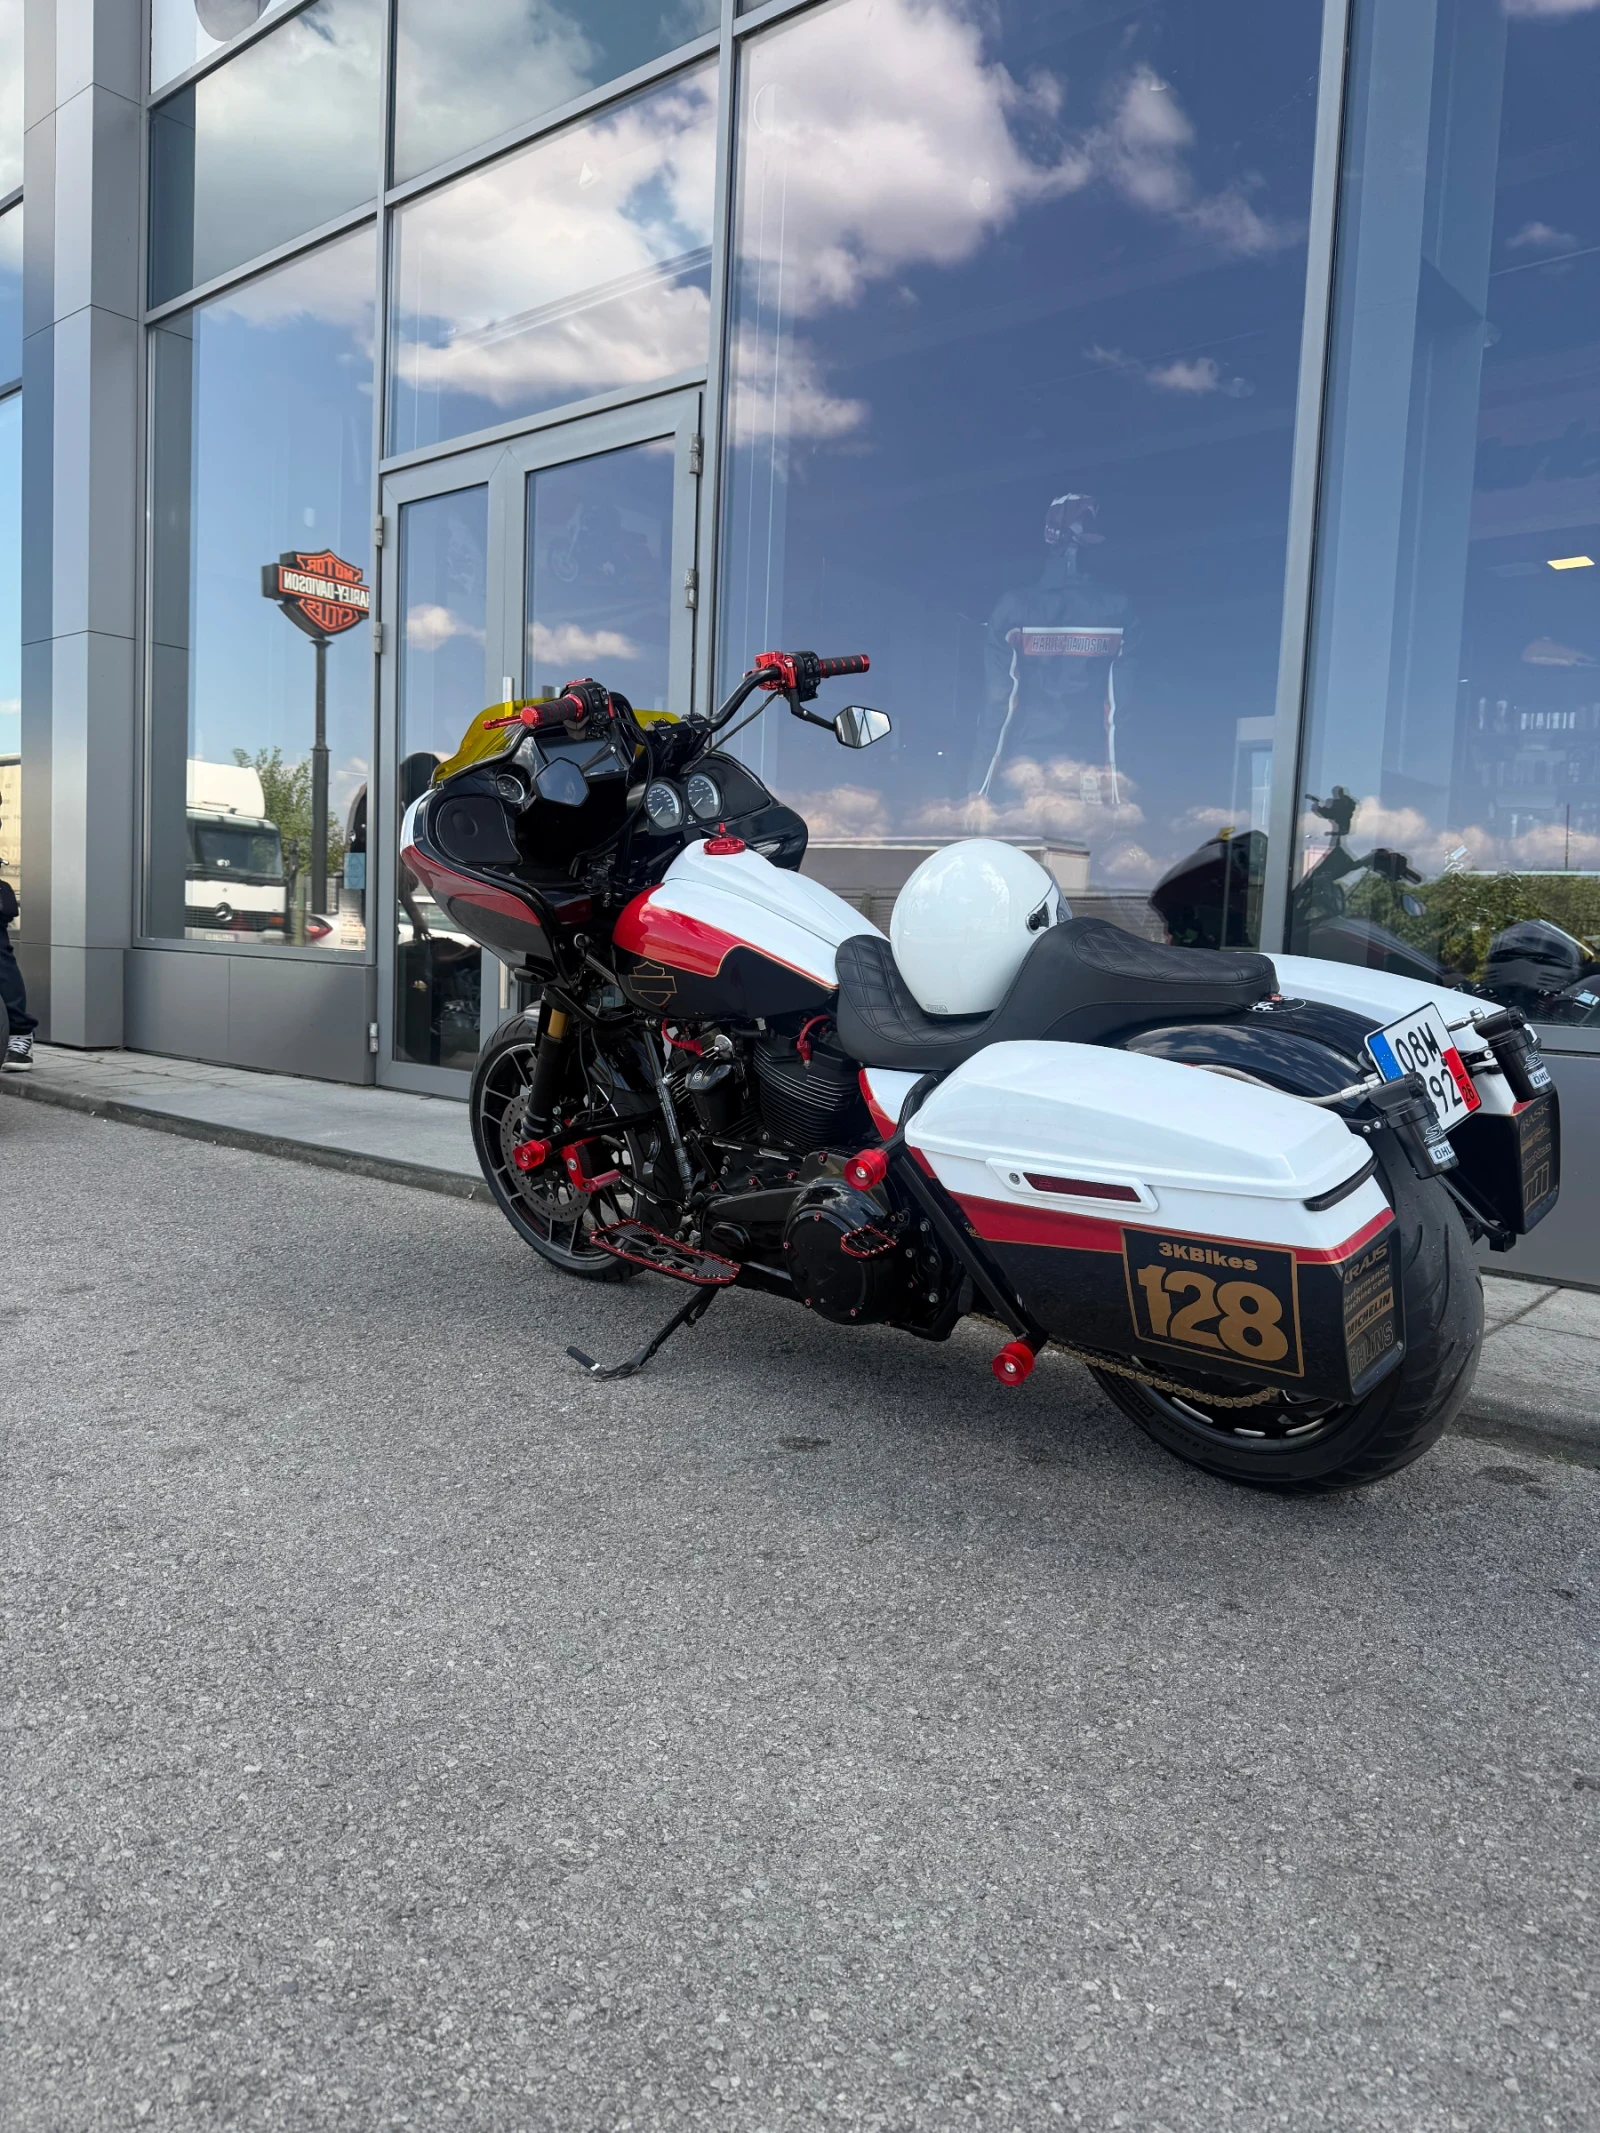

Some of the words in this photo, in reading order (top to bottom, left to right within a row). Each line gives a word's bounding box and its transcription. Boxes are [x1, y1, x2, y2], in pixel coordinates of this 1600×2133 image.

[1429, 1068, 1463, 1113] 92
[1461, 1083, 1475, 1103] 26
[1159, 1242, 1258, 1271] 3KBikes
[1137, 1264, 1289, 1362] 128
[1347, 1292, 1391, 1336] MICHELIN
